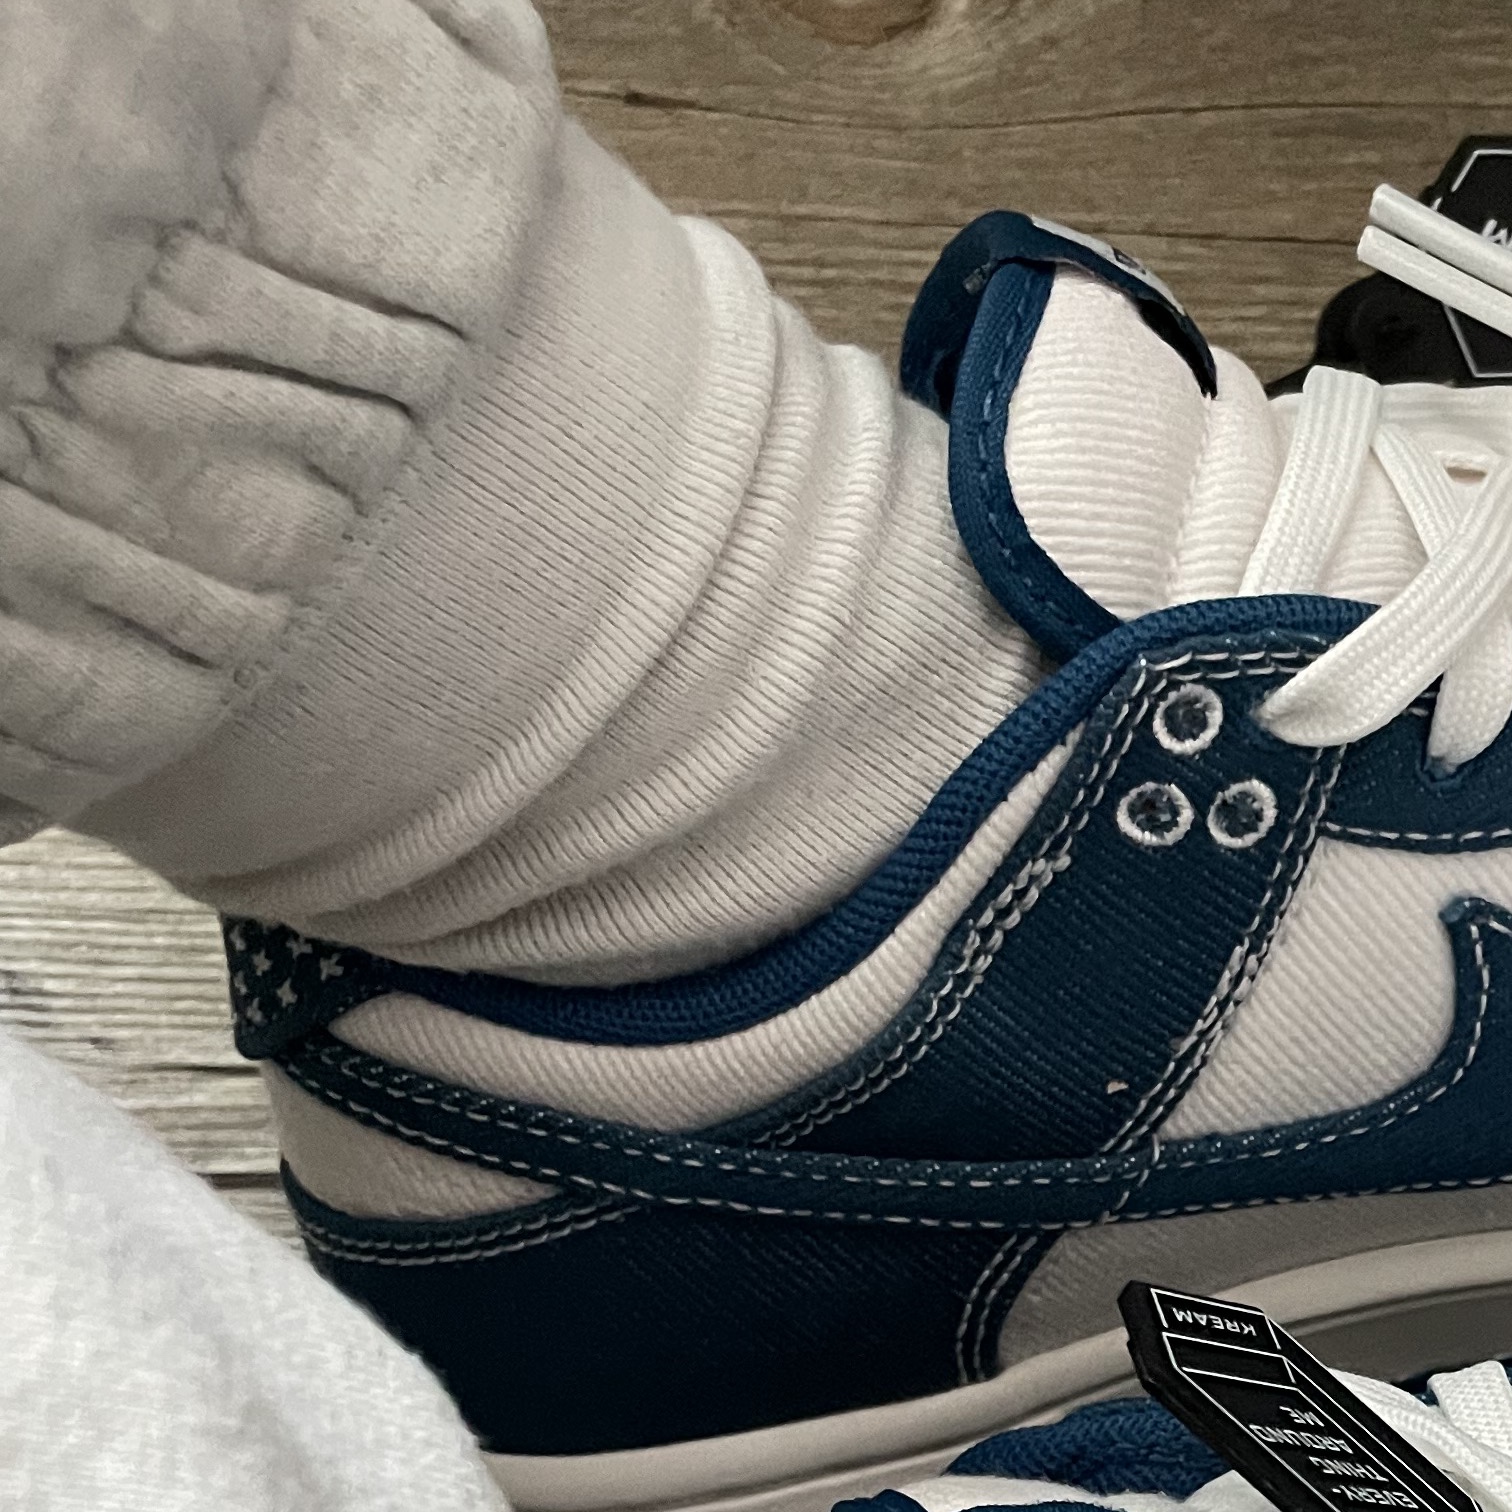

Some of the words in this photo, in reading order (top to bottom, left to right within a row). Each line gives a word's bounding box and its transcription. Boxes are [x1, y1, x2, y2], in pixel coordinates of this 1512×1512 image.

[1173, 1307, 1258, 1336] KREAM
[1279, 1405, 1326, 1428] ME
[1247, 1423, 1355, 1455] AROUND
[1311, 1457, 1388, 1482] THING
[1331, 1485, 1418, 1509] EVERY-
